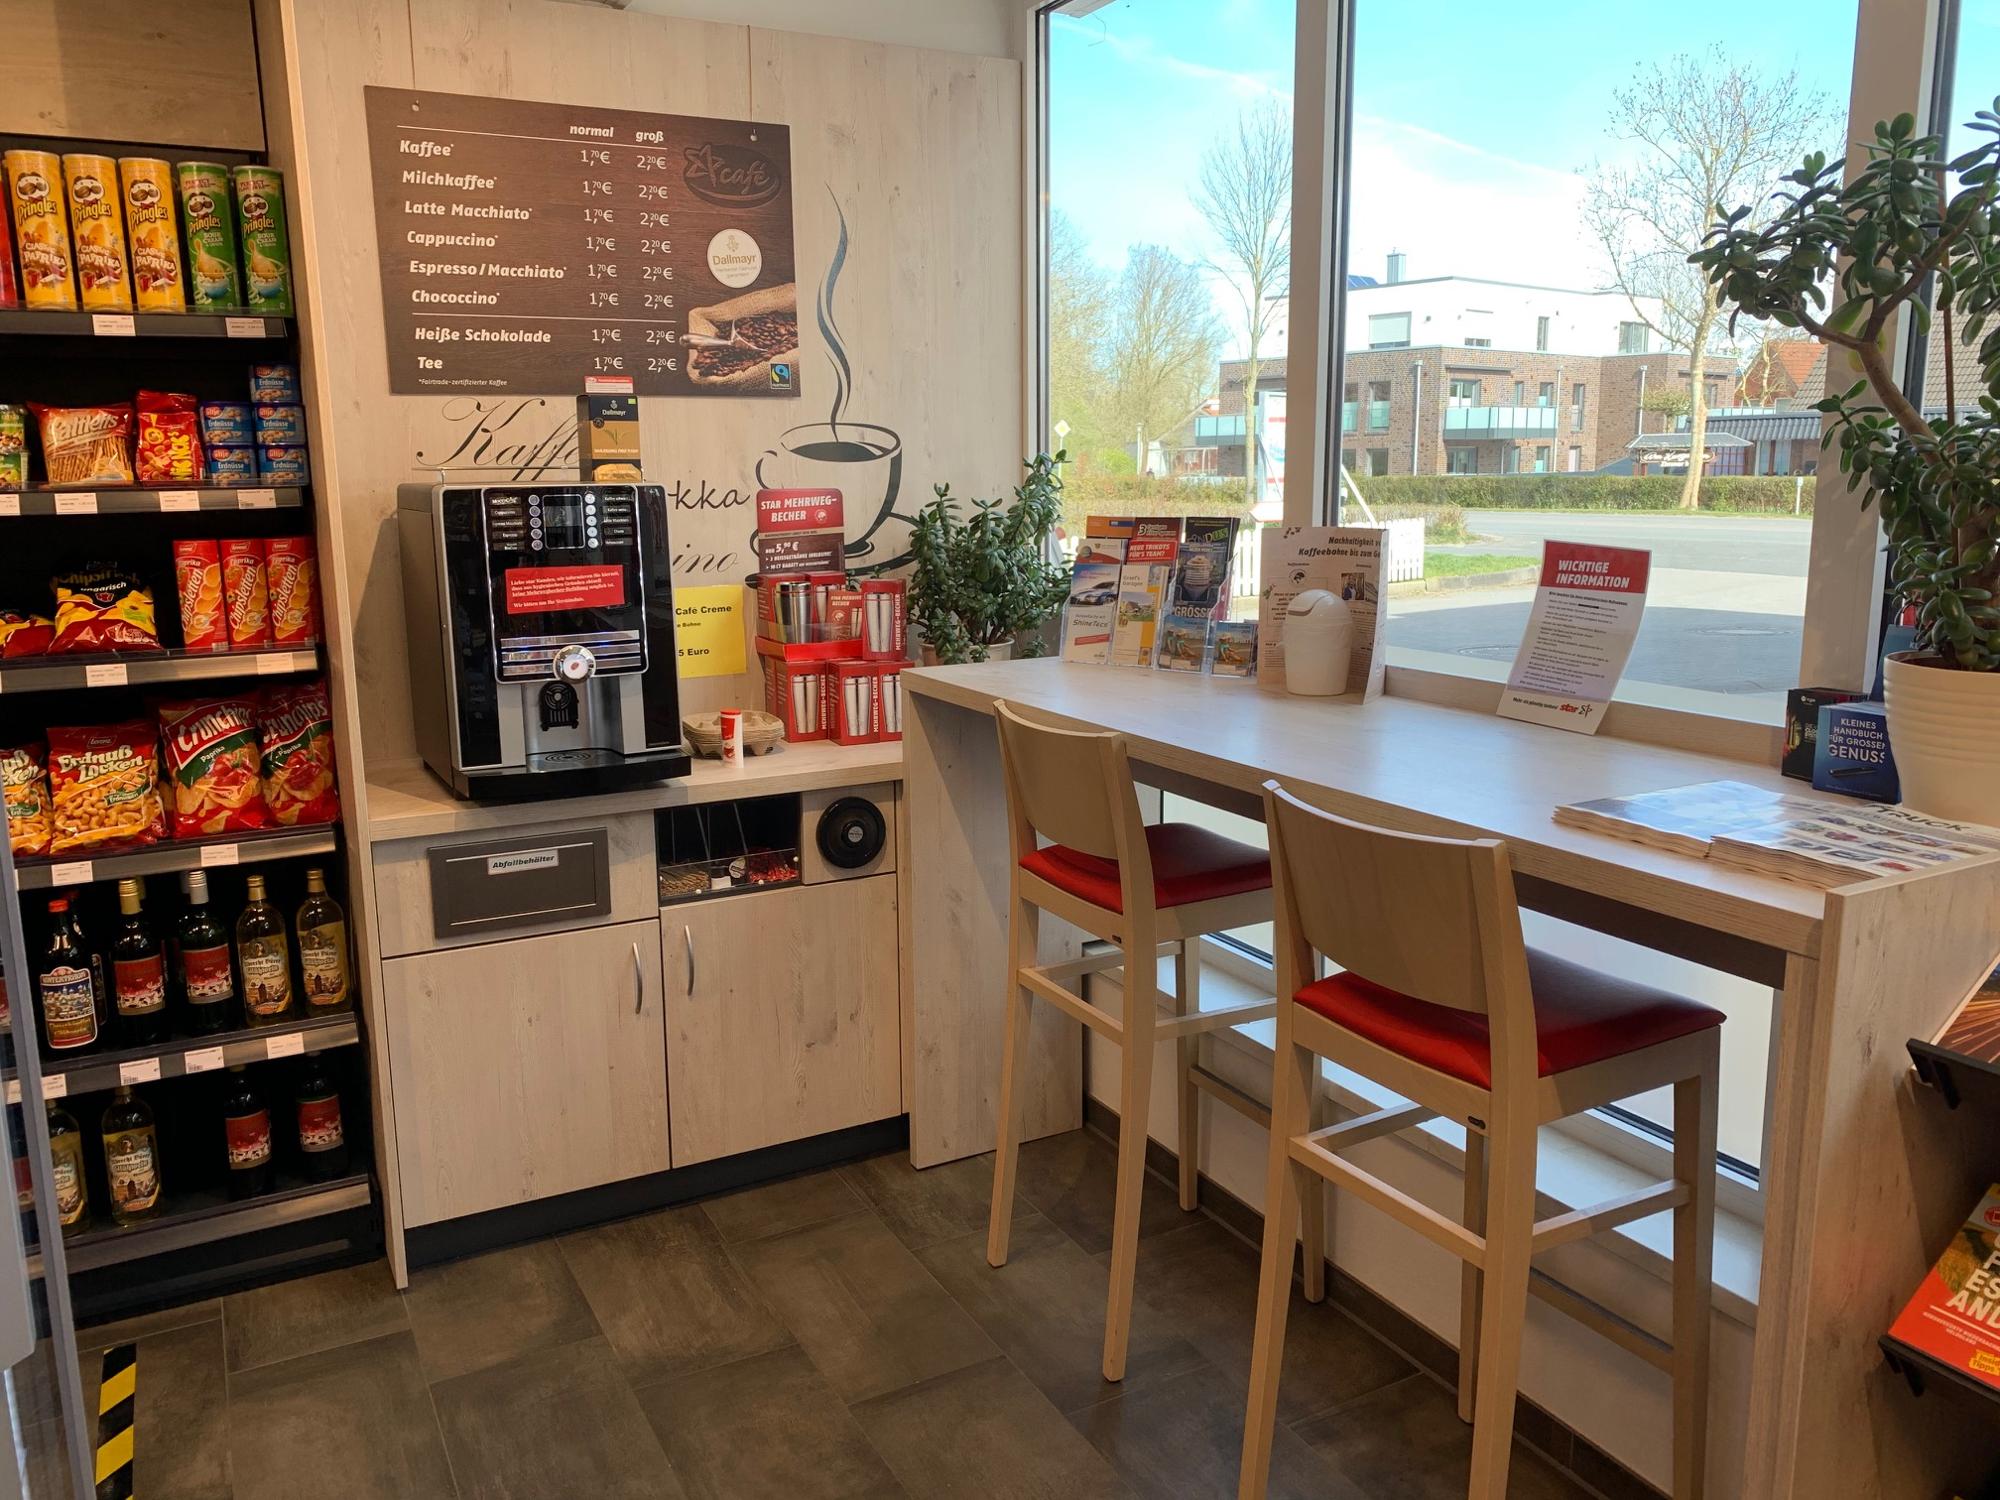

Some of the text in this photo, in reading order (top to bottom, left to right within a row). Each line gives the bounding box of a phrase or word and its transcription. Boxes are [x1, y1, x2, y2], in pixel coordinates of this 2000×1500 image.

[569, 125, 664, 144] normal groß
[18, 200, 57, 226] Pringles
[405, 201, 446, 215] Latte
[74, 203, 112, 228] Pringles
[130, 205, 168, 232] Pringles
[189, 215, 221, 237] Pringles
[242, 216, 274, 238] Pringles
[24, 251, 66, 266] PAPRIKA
[80, 254, 120, 268] PAPRIKA
[136, 256, 176, 270] PAPRIKA
[712, 254, 757, 266] Dallmayr
[415, 327, 460, 343] Heiße
[465, 328, 552, 342] Schokolade
[418, 356, 443, 368] Tee
[761, 496, 837, 510] STAR MEHRWEG-
[771, 510, 806, 522] BECHER
[1328, 536, 1374, 547] Nachhaltigkeit
[1298, 548, 1348, 556] Kaffeebohne
[1558, 560, 1610, 574] WICHTIGE
[1556, 573, 1630, 588] INFORMATION
[229, 566, 257, 628] Chipsletten
[272, 564, 298, 626] Chipsletten
[700, 604, 732, 614] Creme
[687, 648, 710, 656] Euro
[1560, 703, 1579, 713] star
[1841, 718, 1876, 729] KLEINES
[1834, 726, 1883, 740] HANDBUCH
[58, 744, 133, 773] Erdnuß
[200, 745, 225, 763] Paprika
[78, 756, 144, 784] Locken
[492, 856, 554, 868] Abfallbehälter
